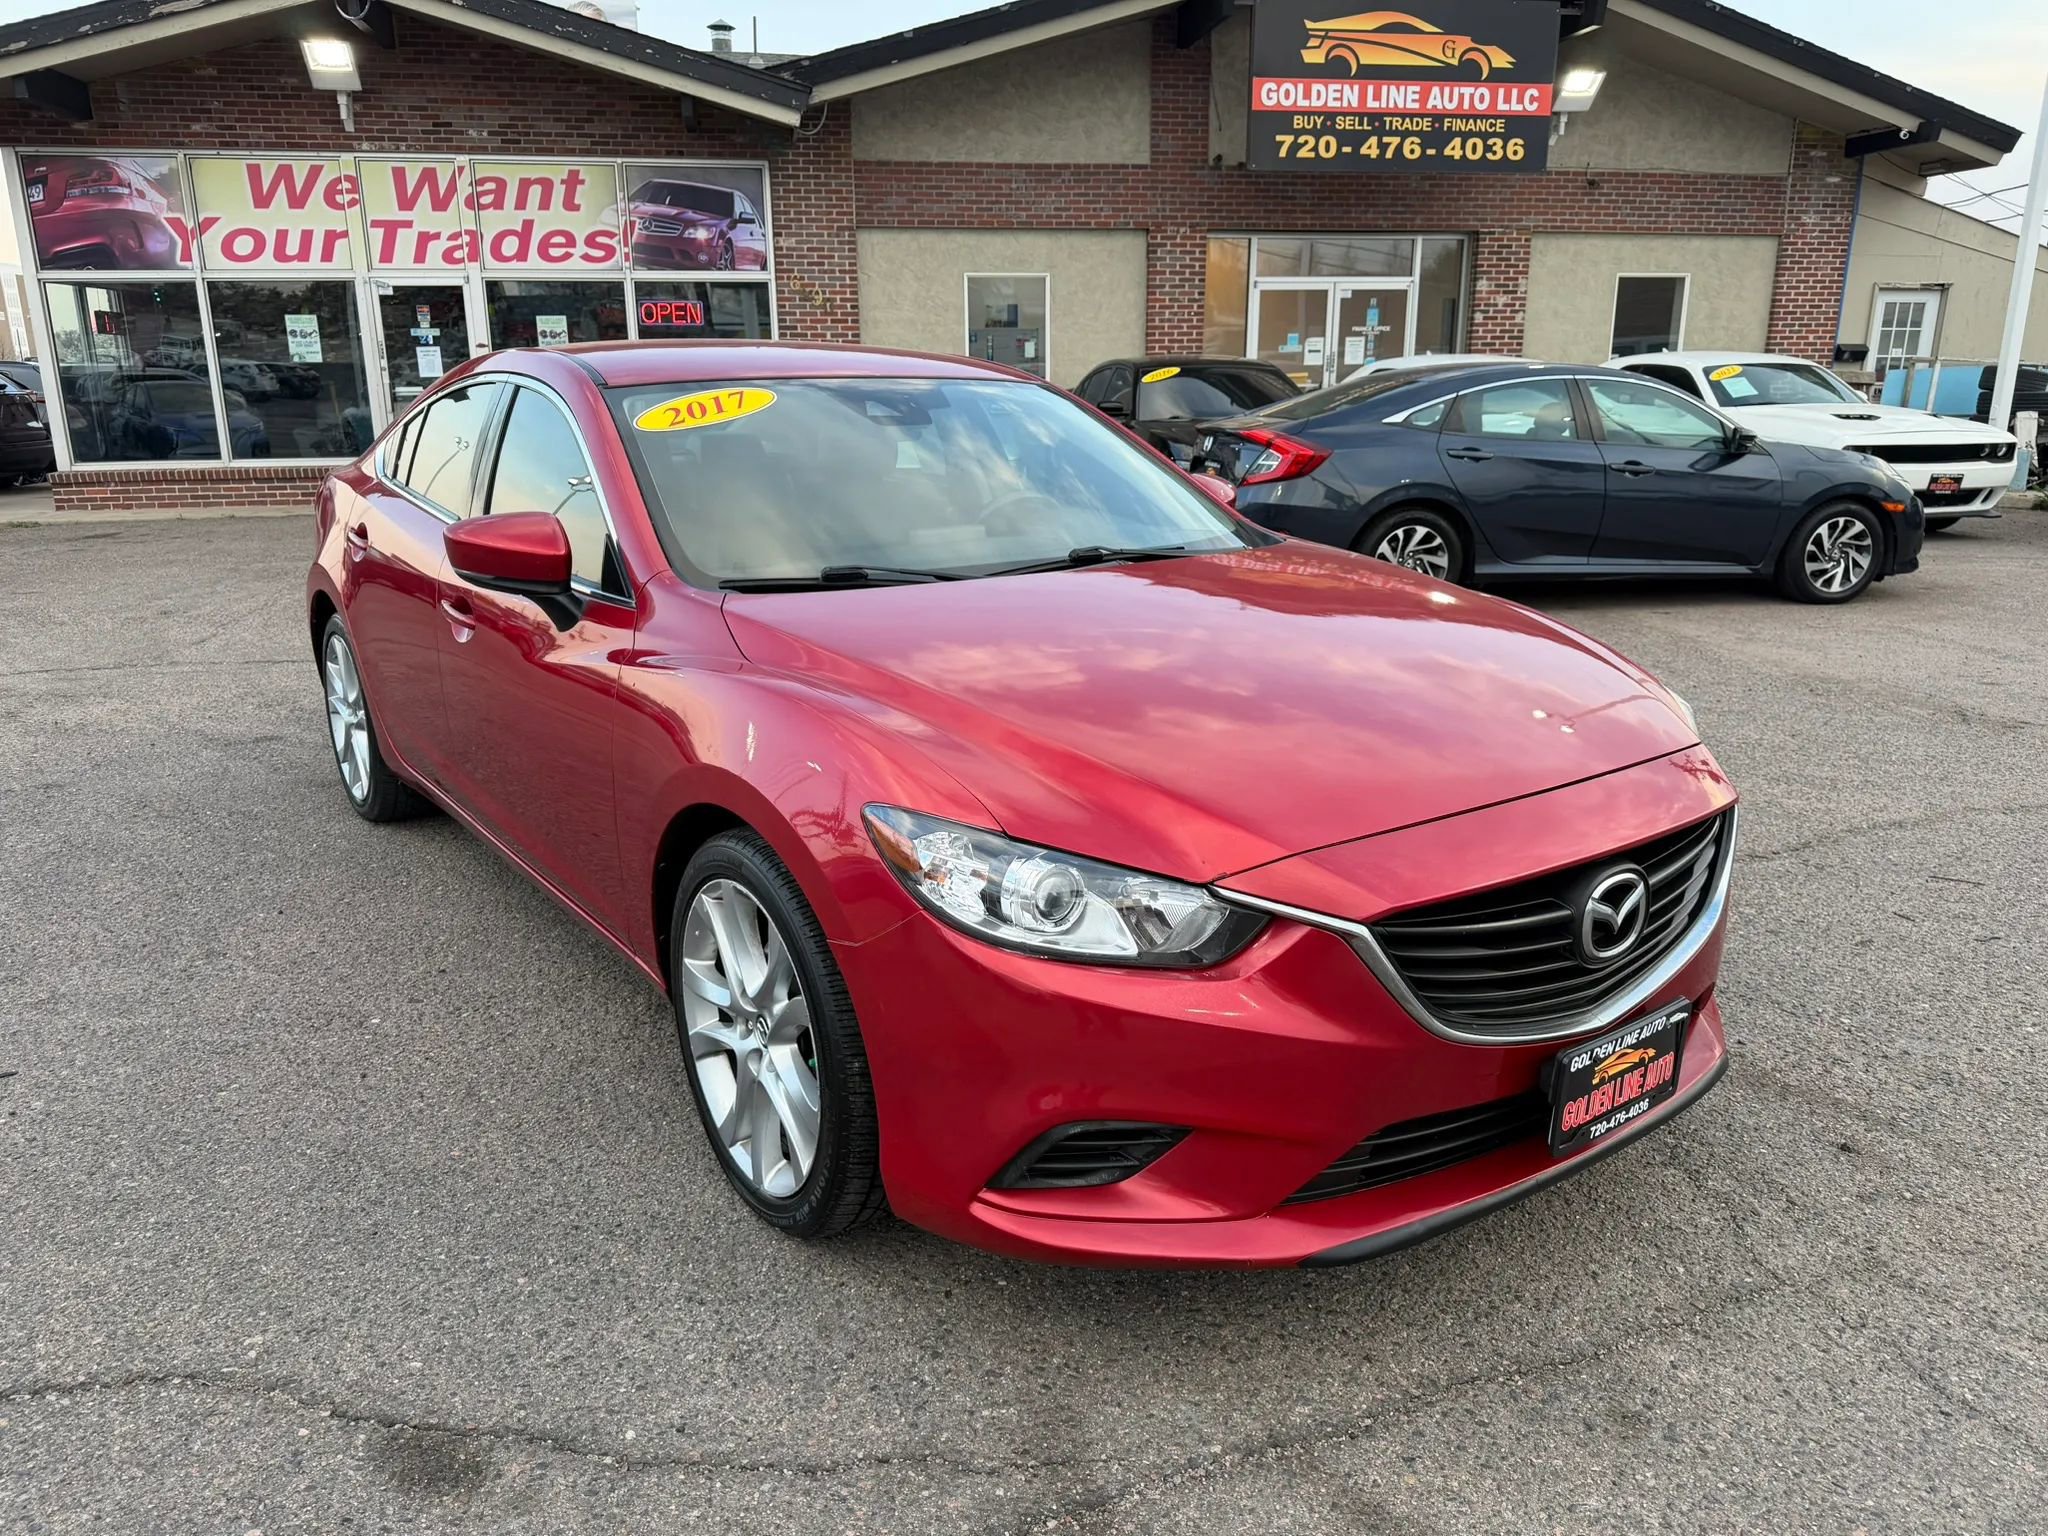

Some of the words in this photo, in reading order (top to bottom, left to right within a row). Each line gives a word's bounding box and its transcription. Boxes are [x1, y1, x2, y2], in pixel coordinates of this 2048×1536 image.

[1260, 81, 1359, 108] GOLDEN
[1365, 84, 1420, 110] LINE
[1426, 85, 1490, 111] AUTO
[1496, 87, 1540, 112] LLC
[1292, 115, 1325, 130] BUY
[1335, 116, 1372, 131] SELL
[1384, 116, 1432, 132] TRADE
[1443, 117, 1506, 133] FINANCE
[245, 163, 360, 211] We
[391, 165, 586, 213] Want
[164, 216, 350, 264] Your
[369, 218, 638, 265] Trades!
[641, 302, 701, 325] OPEN
[663, 390, 745, 427] 2017
[1570, 1040, 1616, 1073] GOLDEN
[1615, 1028, 1641, 1052] LINE
[1639, 1015, 1667, 1041] AUTO
[1561, 1080, 1615, 1132] GOLDEN
[1614, 1067, 1645, 1107] LINE
[1643, 1051, 1675, 1093] AUTO
[1590, 1098, 1650, 1139] 720-476-4036
